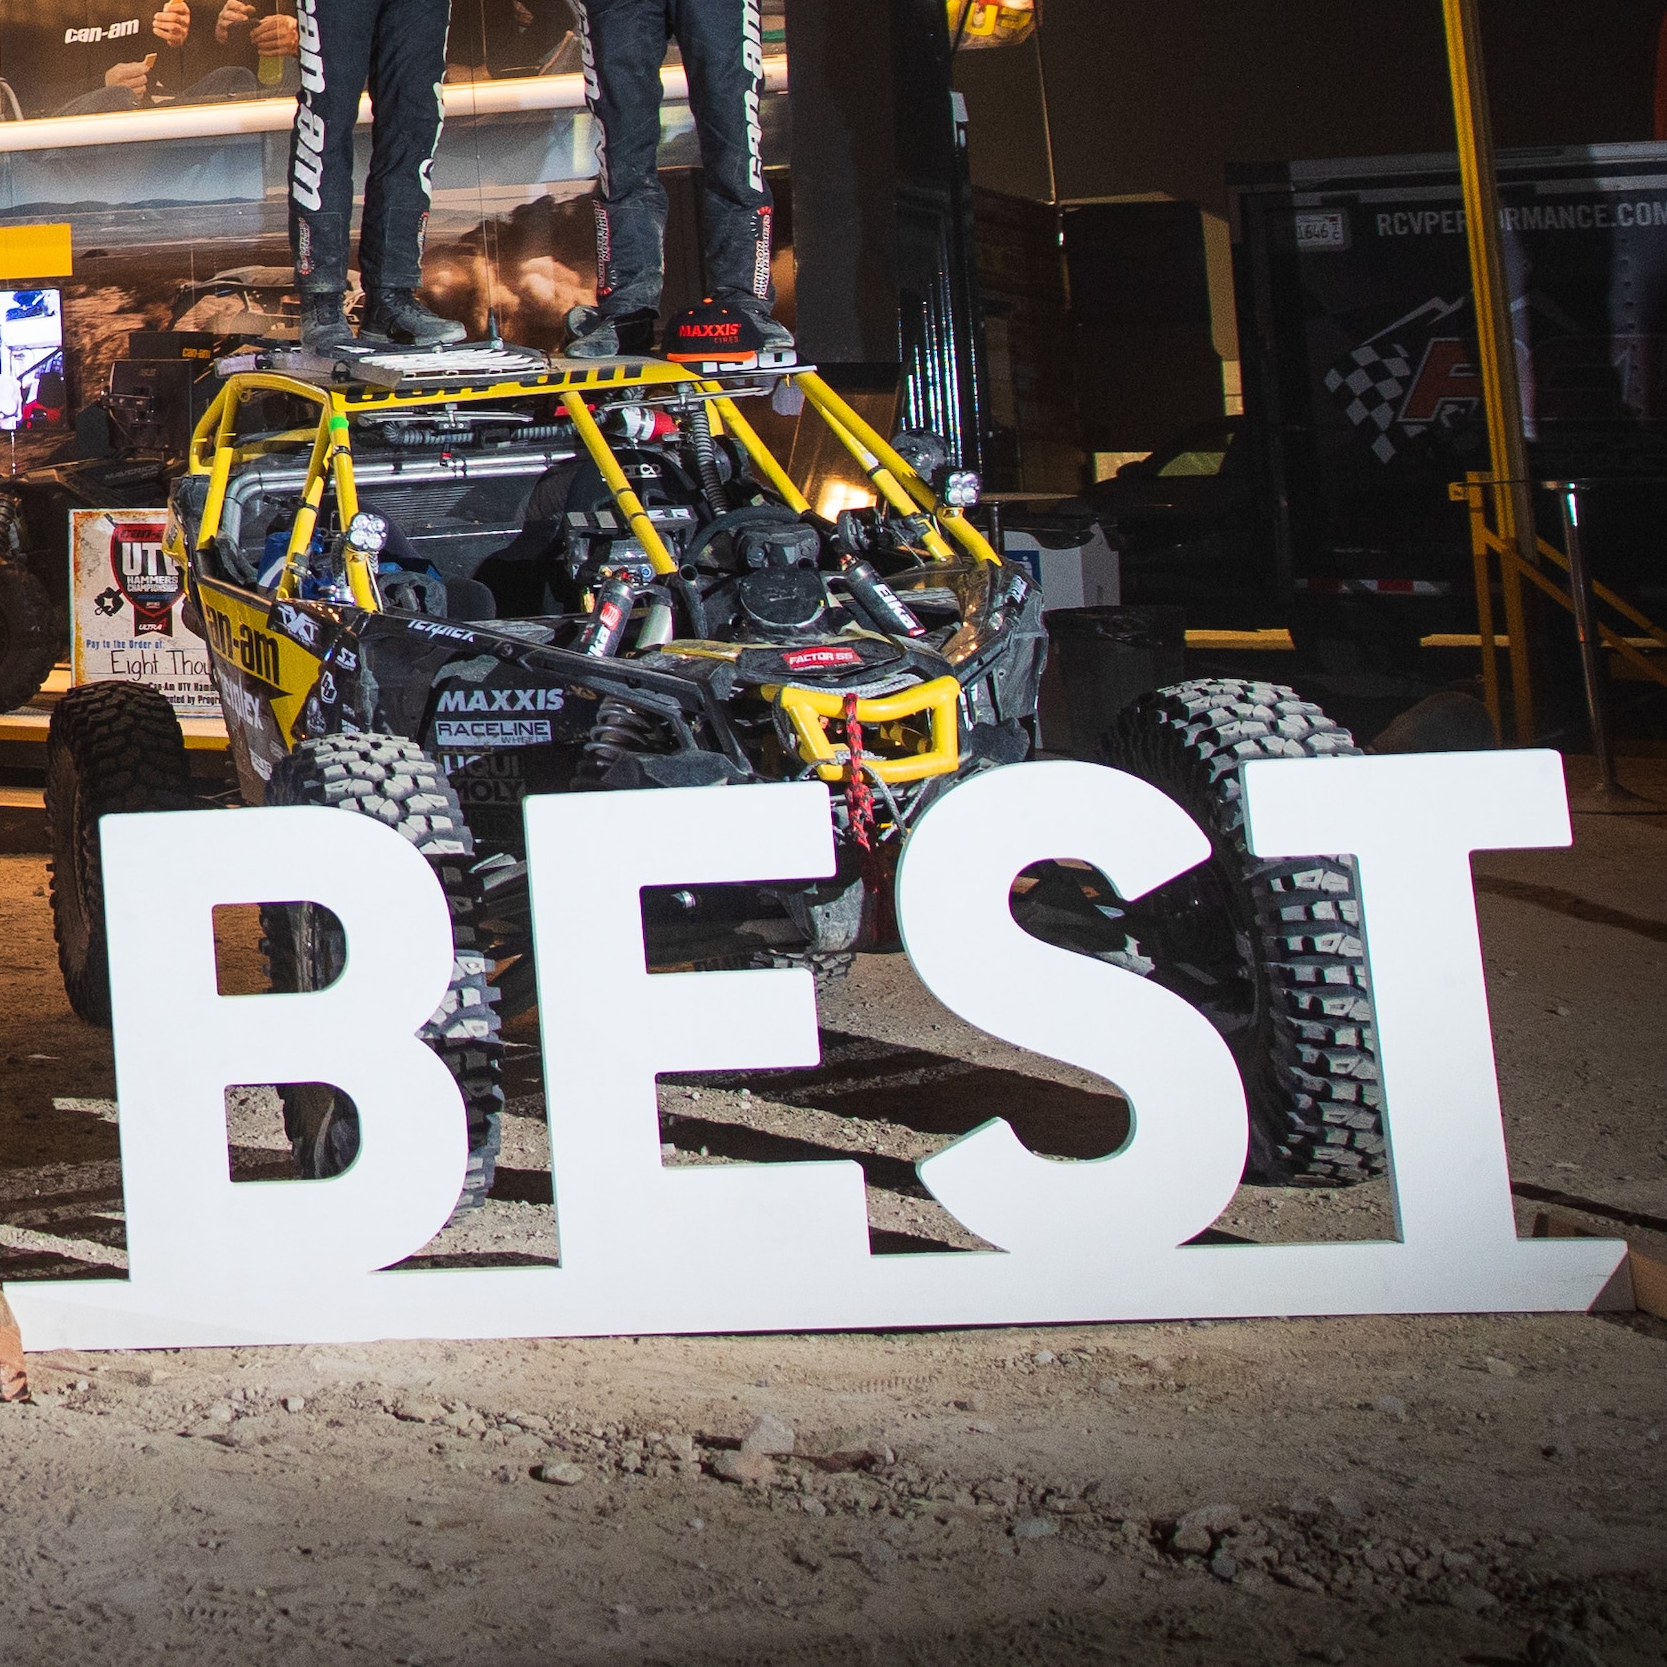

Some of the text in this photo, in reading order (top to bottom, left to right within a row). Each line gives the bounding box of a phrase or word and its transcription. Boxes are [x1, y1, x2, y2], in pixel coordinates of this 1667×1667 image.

[63, 17, 140, 45] can-am
[1378, 200, 1667, 237] RCVPERMANCE.COM
[679, 323, 741, 337] MAXXIS
[714, 336, 739, 344] TIRES
[182, 347, 212, 359] can-am
[126, 575, 179, 585] HAMMERS
[126, 584, 179, 592] CHAMPIONSHIP
[86, 639, 152, 650] Pay to the Order
[111, 650, 160, 681] Eight
[788, 651, 855, 667] FACTOR 55
[178, 682, 191, 692] UTV
[188, 695, 195, 705] by
[437, 688, 565, 713] MAXXIS
[438, 721, 549, 737] RACELINE
[443, 754, 518, 776] LIQUI
[98, 748, 1573, 1274] BEST
